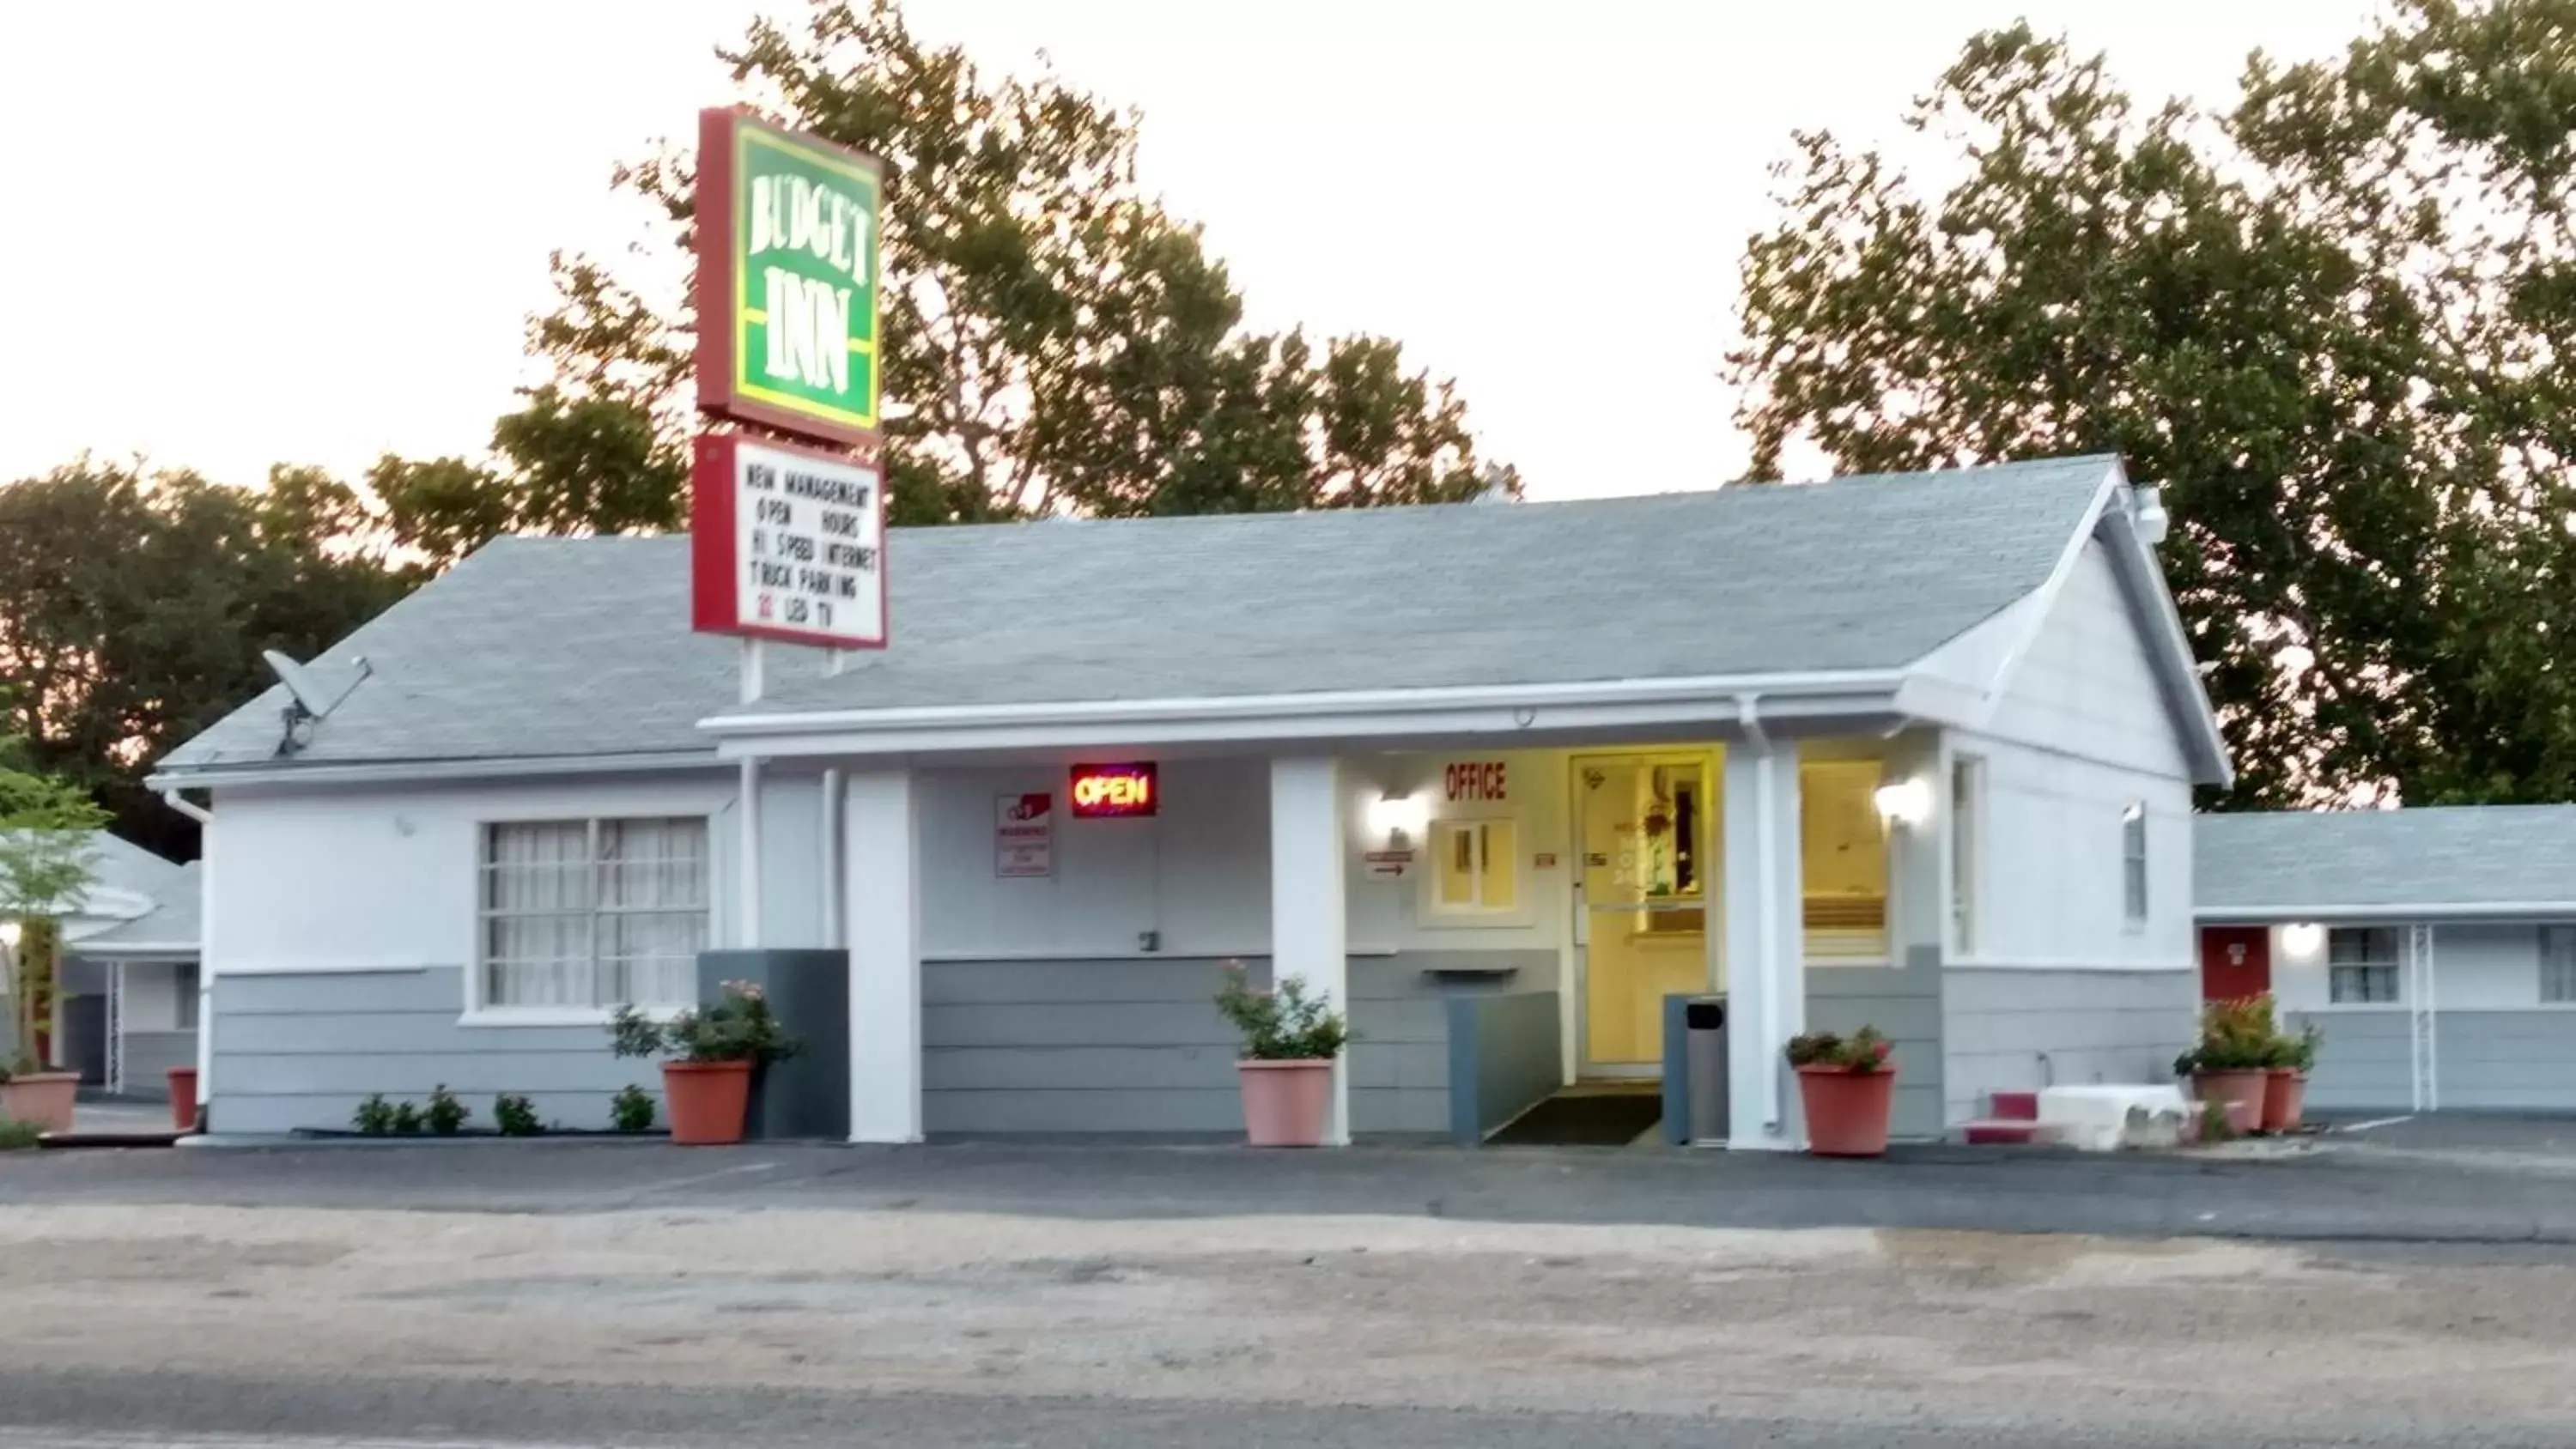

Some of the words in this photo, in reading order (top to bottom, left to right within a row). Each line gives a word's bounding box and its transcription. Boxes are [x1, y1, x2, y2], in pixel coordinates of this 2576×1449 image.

[750, 173, 871, 285] BUDGET
[764, 267, 852, 394] INN
[747, 465, 775, 490] NEW
[785, 471, 870, 507] MANAGEMENT
[756, 499, 792, 524] OPEN
[822, 512, 859, 537] HOURS
[778, 534, 814, 561] SPEED
[821, 542, 877, 571] INTERNET
[750, 561, 791, 587] TRUCK
[800, 570, 856, 597] PARKING
[817, 603, 832, 626] TV
[1075, 776, 1147, 805] OPEN
[1446, 763, 1506, 801] OFFICE
